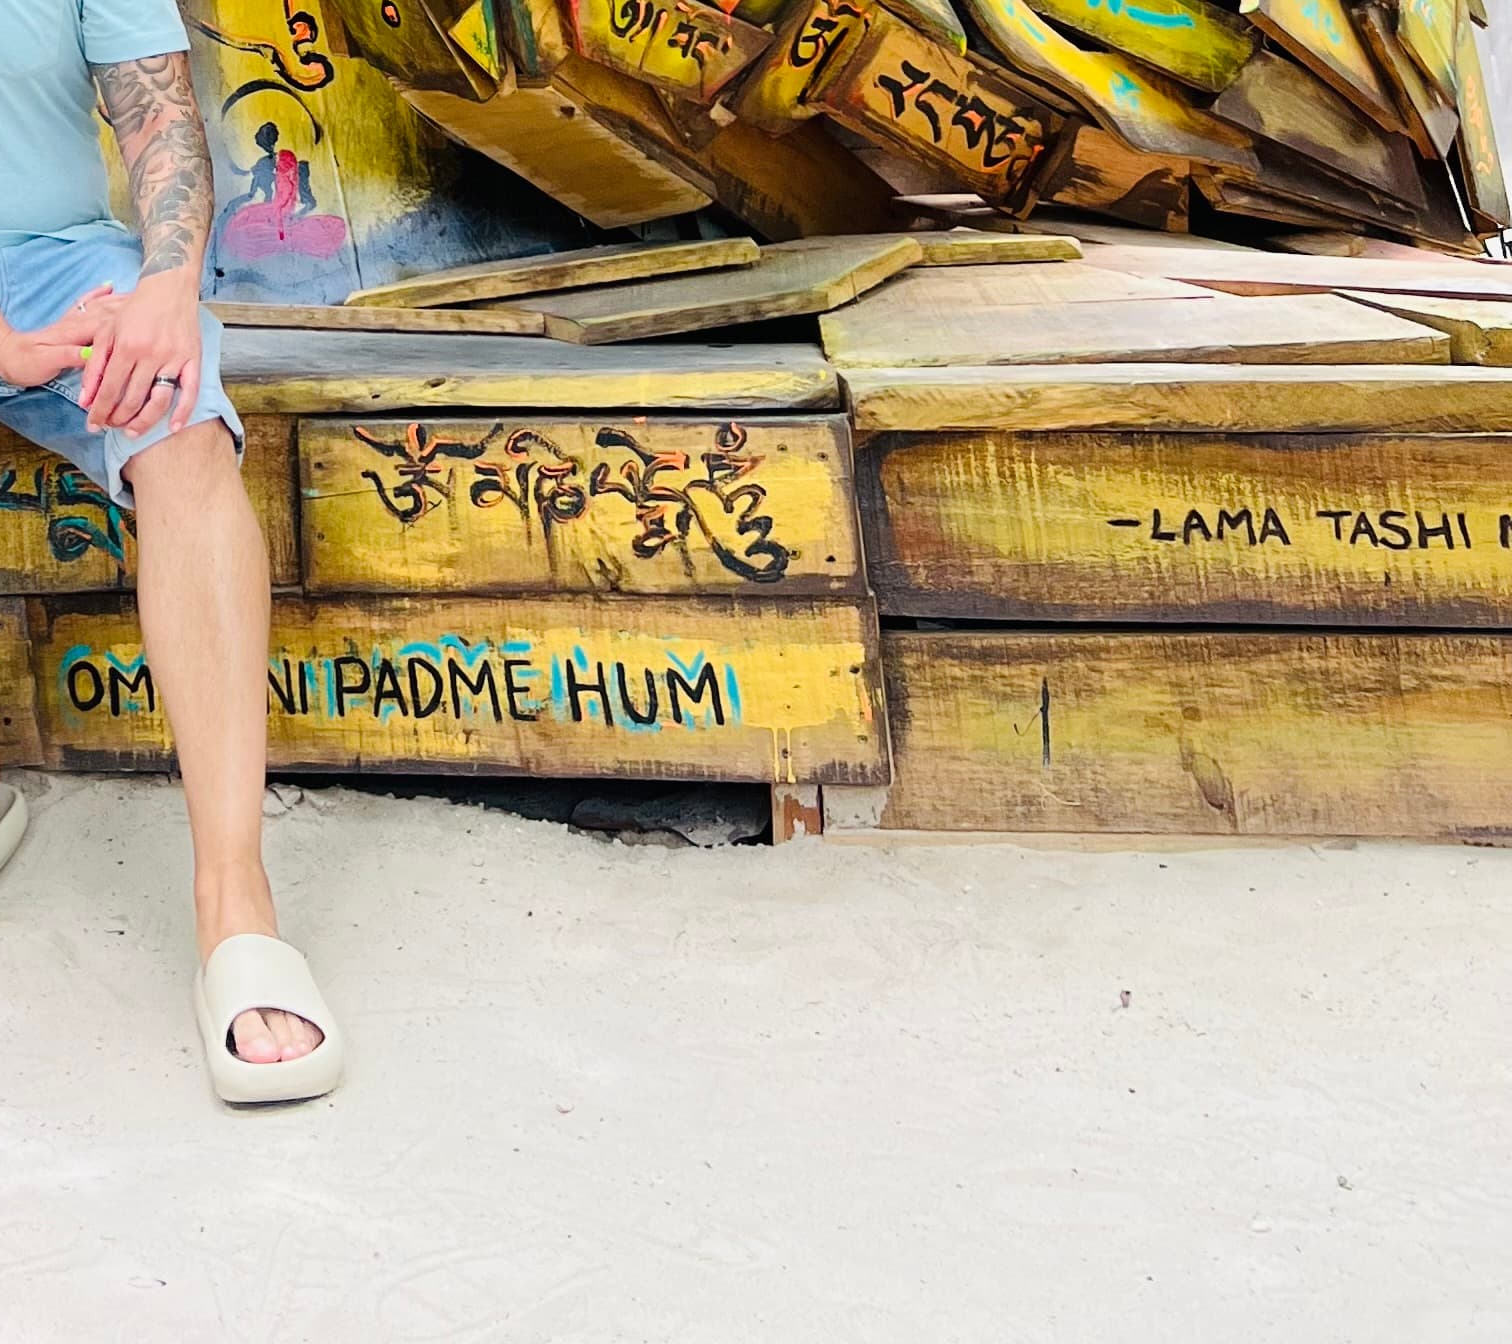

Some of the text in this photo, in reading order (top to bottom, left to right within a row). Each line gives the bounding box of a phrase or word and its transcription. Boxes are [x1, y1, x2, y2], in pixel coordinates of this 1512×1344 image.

[1316, 509, 1472, 551] TASHI
[66, 654, 726, 727] OM NI PADME HUM
